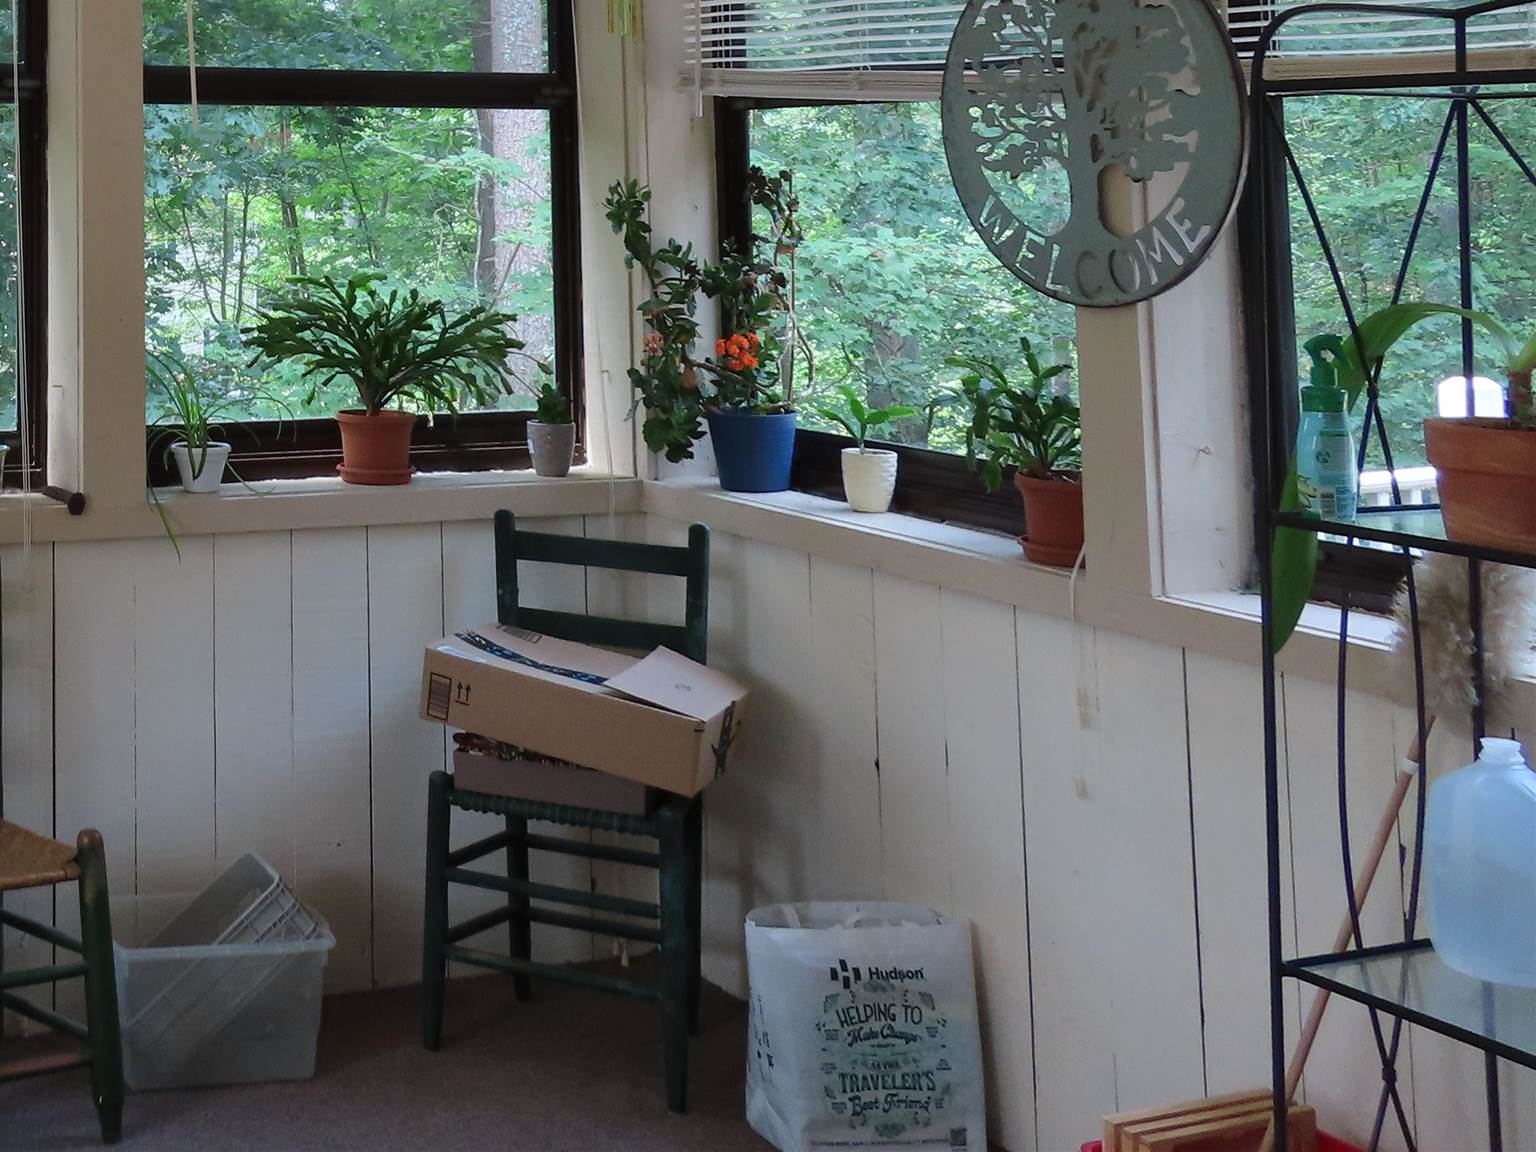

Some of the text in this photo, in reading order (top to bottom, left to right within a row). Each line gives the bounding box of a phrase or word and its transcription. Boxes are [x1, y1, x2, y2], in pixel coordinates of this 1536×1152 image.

[979, 194, 1211, 300] WELCOME
[868, 966, 924, 982] Hudson
[835, 1003, 923, 1028] HELPING TO
[838, 1070, 936, 1094] TRAVELER'S
